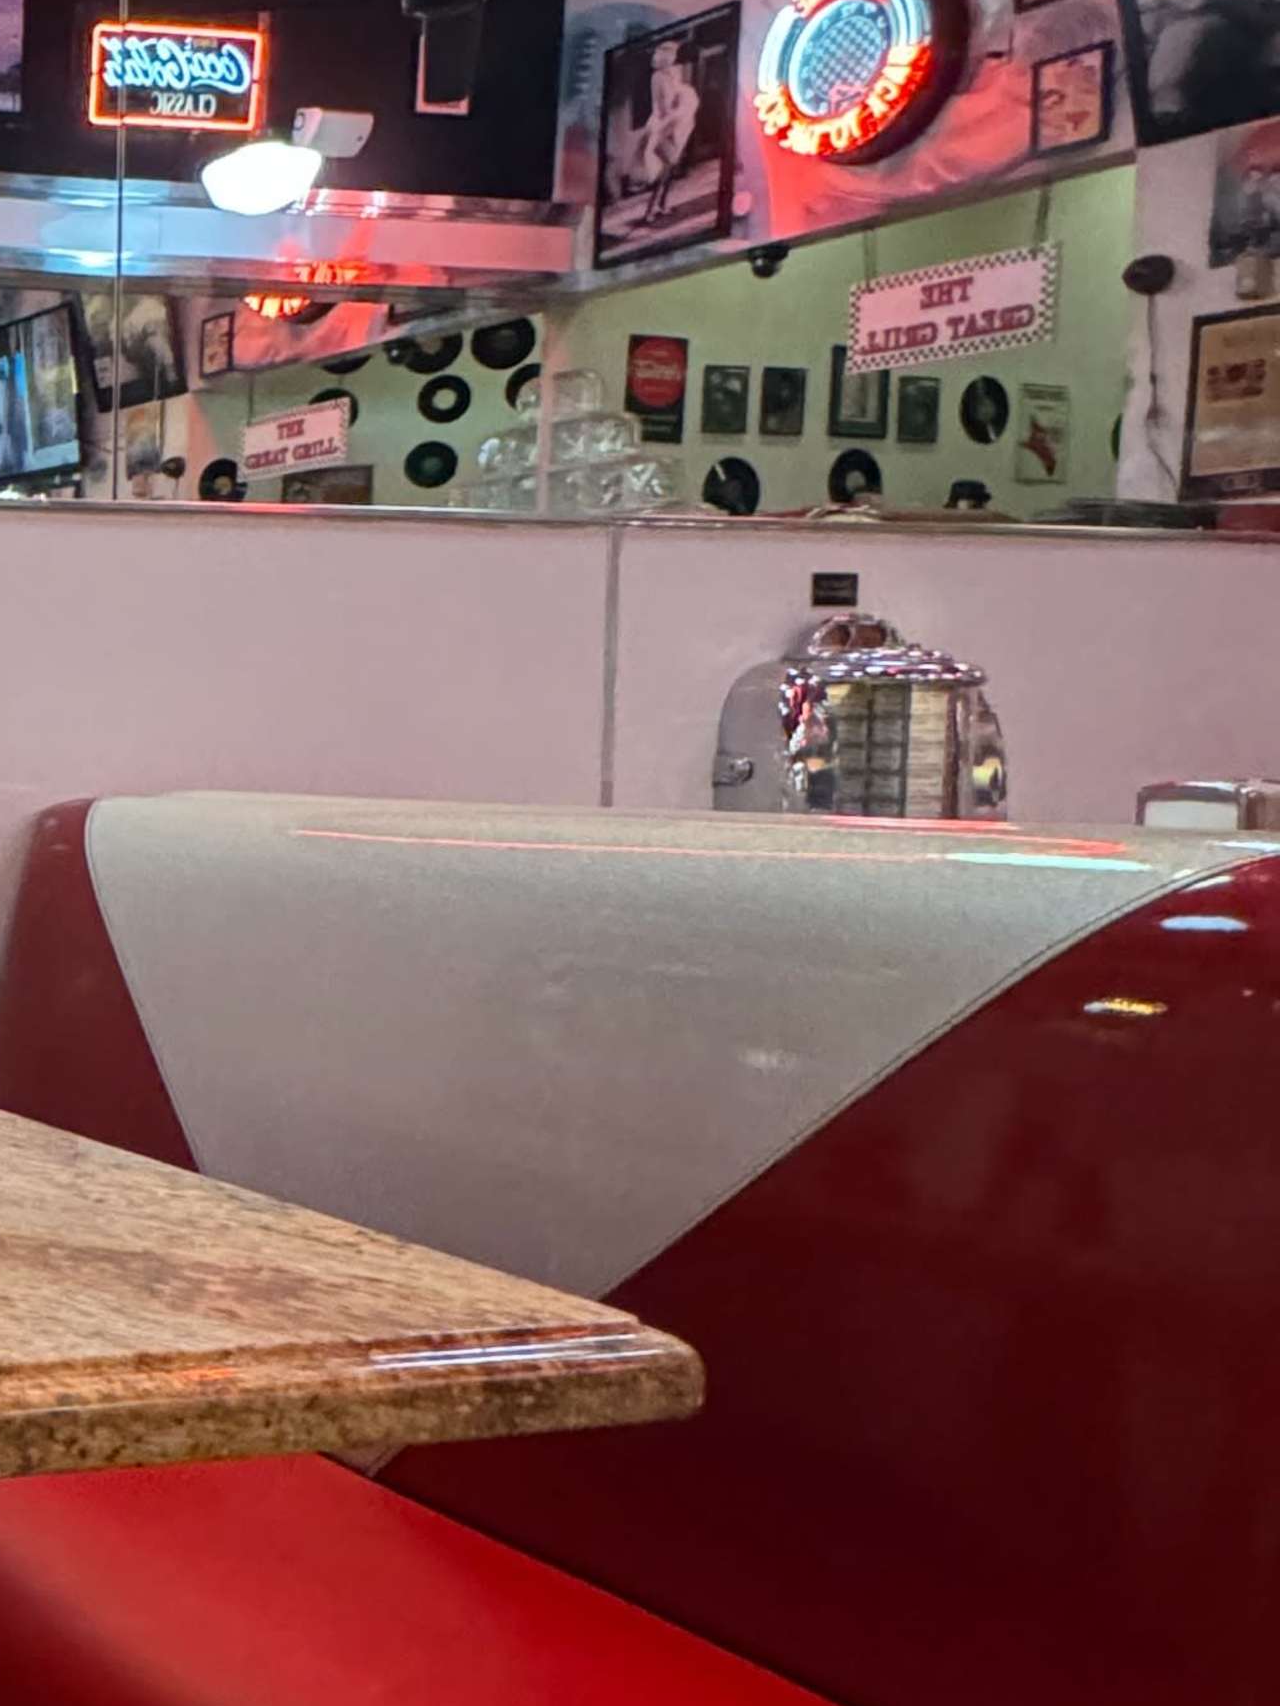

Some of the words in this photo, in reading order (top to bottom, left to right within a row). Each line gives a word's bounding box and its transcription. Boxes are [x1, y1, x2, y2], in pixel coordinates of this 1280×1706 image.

[277, 418, 306, 440] THE
[245, 447, 289, 470] GREAT
[292, 437, 339, 461] GRILL
